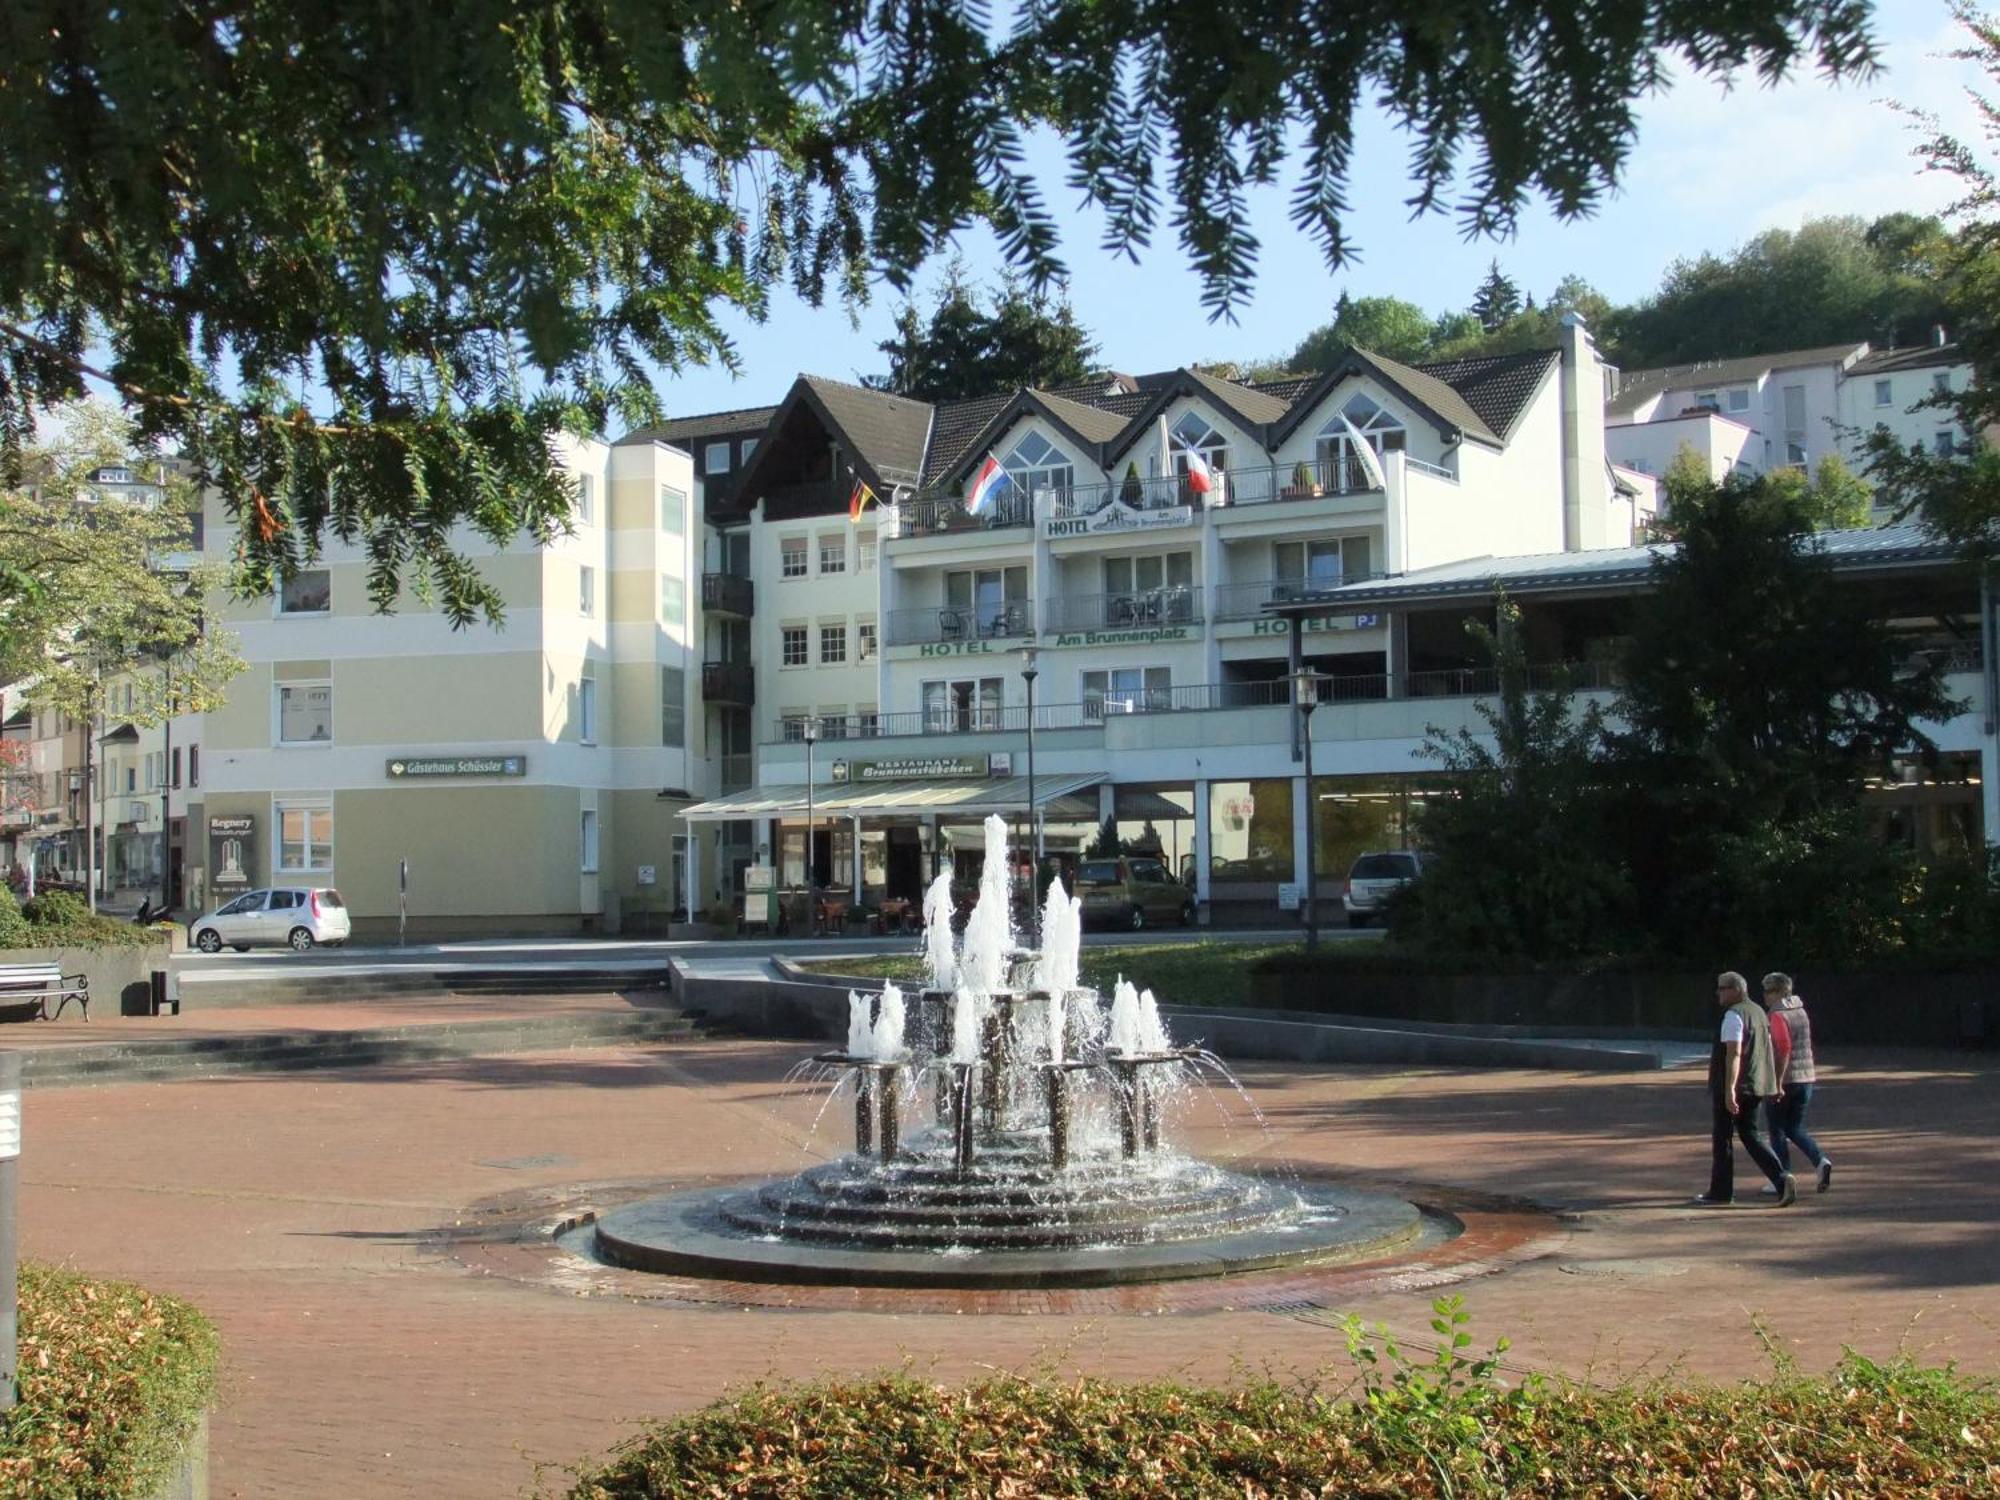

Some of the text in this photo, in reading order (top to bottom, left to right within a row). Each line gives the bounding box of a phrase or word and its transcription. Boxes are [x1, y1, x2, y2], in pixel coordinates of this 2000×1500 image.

[1047, 520, 1090, 536] HOTEL
[1056, 627, 1187, 647] Am Brunnenplatz
[920, 641, 993, 657] HOTEL
[407, 760, 502, 774] Gästehaus Schüssler
[876, 758, 958, 768] RESTAURANT
